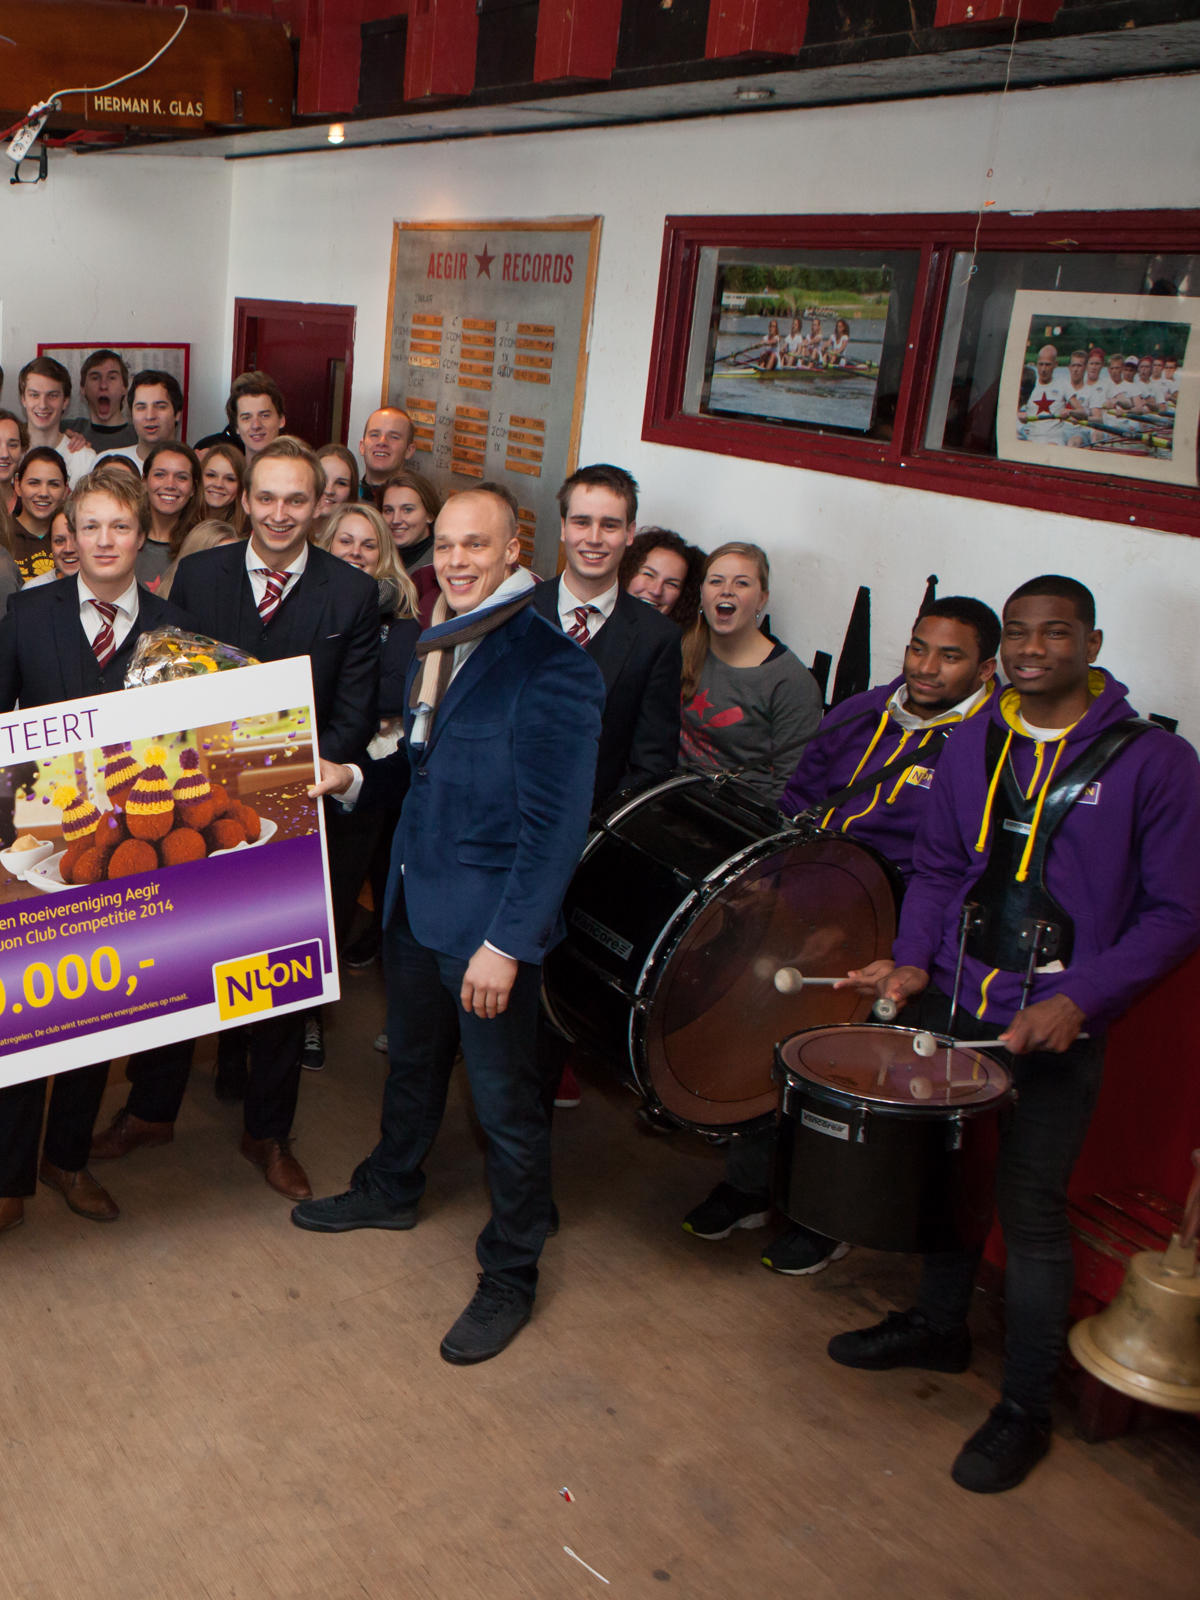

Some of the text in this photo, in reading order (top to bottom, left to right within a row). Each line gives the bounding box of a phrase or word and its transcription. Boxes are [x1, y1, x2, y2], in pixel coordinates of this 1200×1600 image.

[94, 96, 203, 117] HERMAN K. GLAS
[427, 252, 574, 284] AEGIR RECORDS
[19, 892, 122, 926] Roeivereniging
[126, 882, 160, 901] Aegir
[26, 926, 57, 944] Club
[60, 908, 136, 937] Competitie
[139, 899, 174, 918] 2014
[225, 955, 313, 1007] NUON
[35, 1028, 45, 1037] De
[45, 1023, 60, 1035] club
[60, 1020, 76, 1031] wint
[77, 1016, 100, 1027] tevens
[100, 1012, 113, 1021] een
[114, 1001, 159, 1017] energieadvies
[159, 998, 168, 1007] op
[169, 993, 189, 1003] maat.
